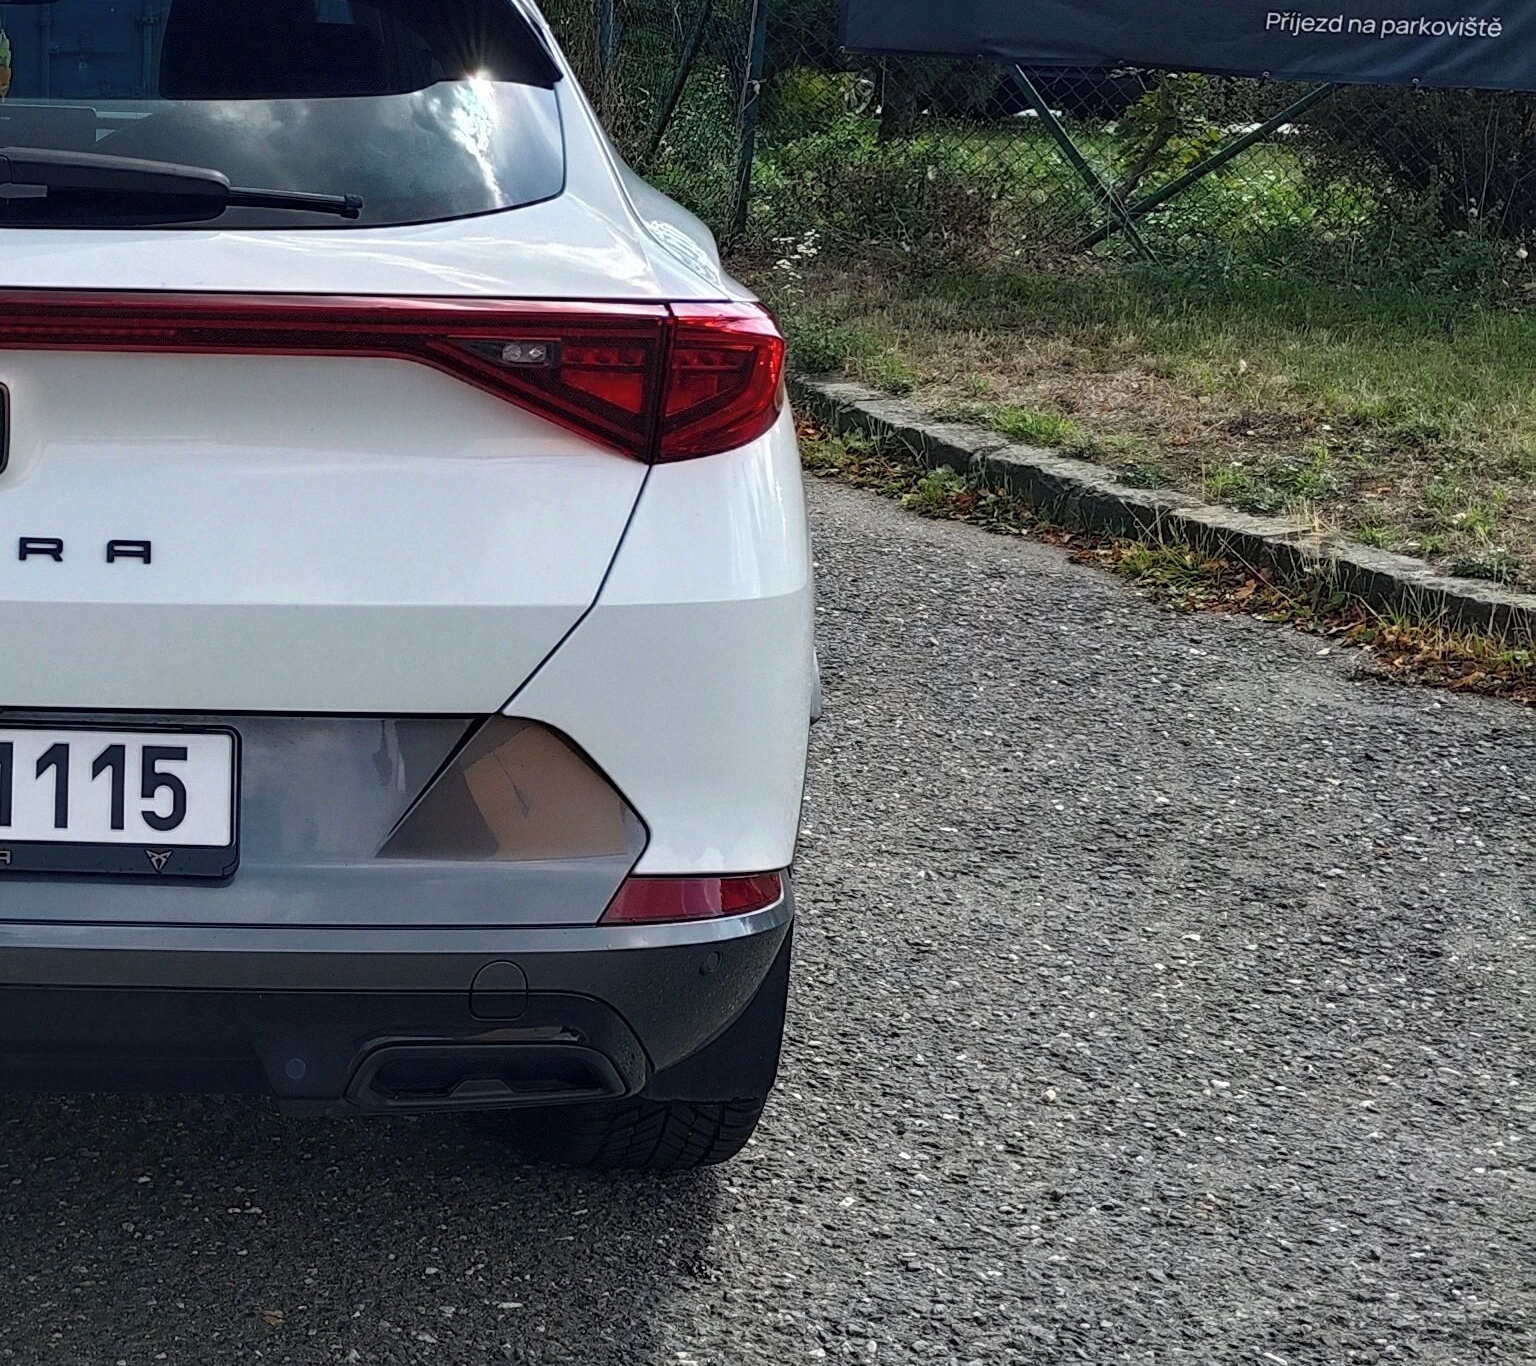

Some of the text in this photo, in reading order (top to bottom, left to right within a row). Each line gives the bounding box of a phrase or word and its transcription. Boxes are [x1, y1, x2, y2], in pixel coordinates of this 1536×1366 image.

[1265, 11, 1503, 38] Příjezd na parkoviště
